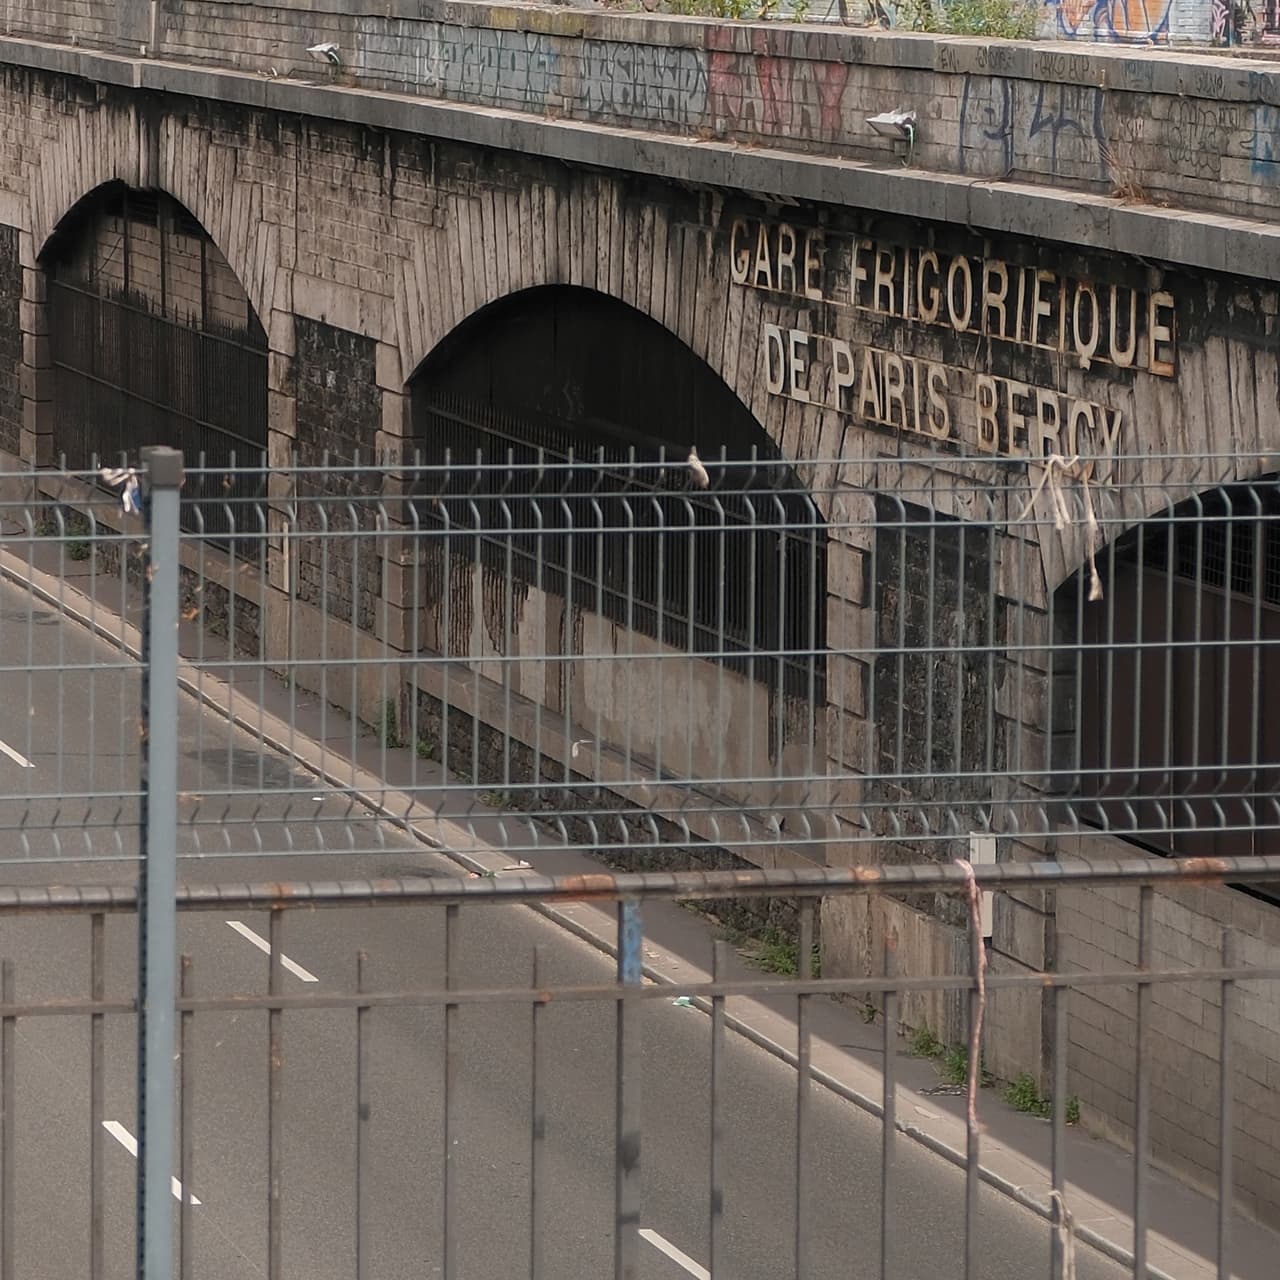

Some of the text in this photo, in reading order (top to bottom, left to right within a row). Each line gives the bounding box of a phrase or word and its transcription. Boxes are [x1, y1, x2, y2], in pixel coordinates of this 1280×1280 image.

[730, 219, 1176, 378] GARE FRIGORIFIQUE
[764, 323, 1123, 488] DE PARIS BERCY
